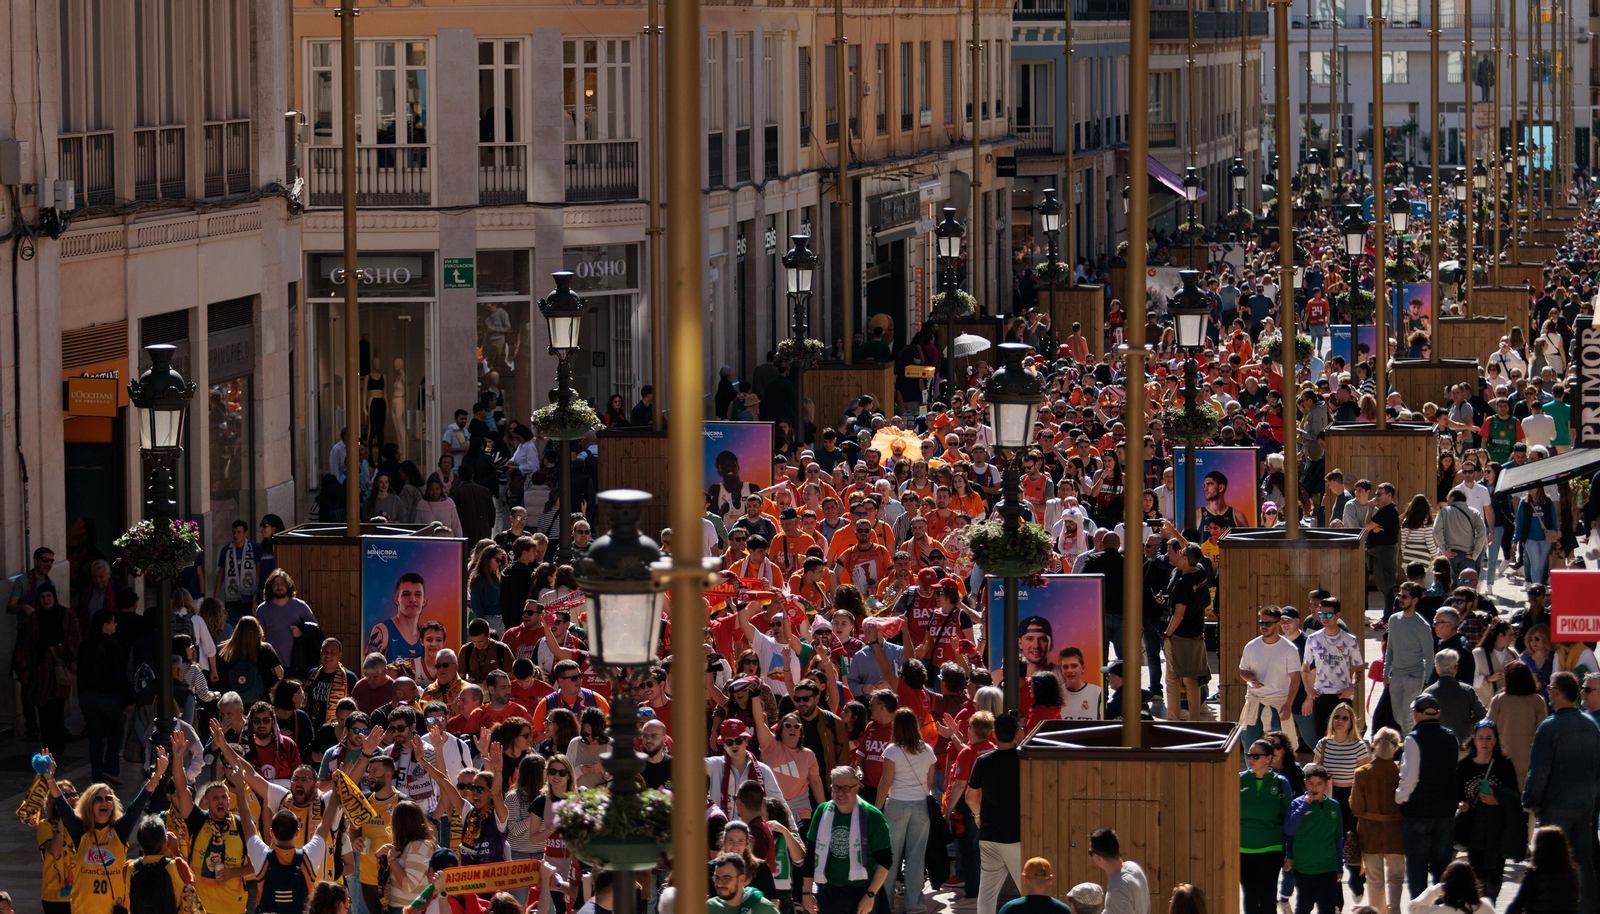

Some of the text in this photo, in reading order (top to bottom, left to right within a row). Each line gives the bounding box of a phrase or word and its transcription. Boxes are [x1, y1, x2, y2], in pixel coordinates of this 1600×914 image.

[329, 267, 411, 285] OSHO
[576, 259, 627, 278] OYSHO
[1311, 306, 1323, 317] 24
[937, 647, 944, 659] 3
[93, 879, 108, 895] 20
